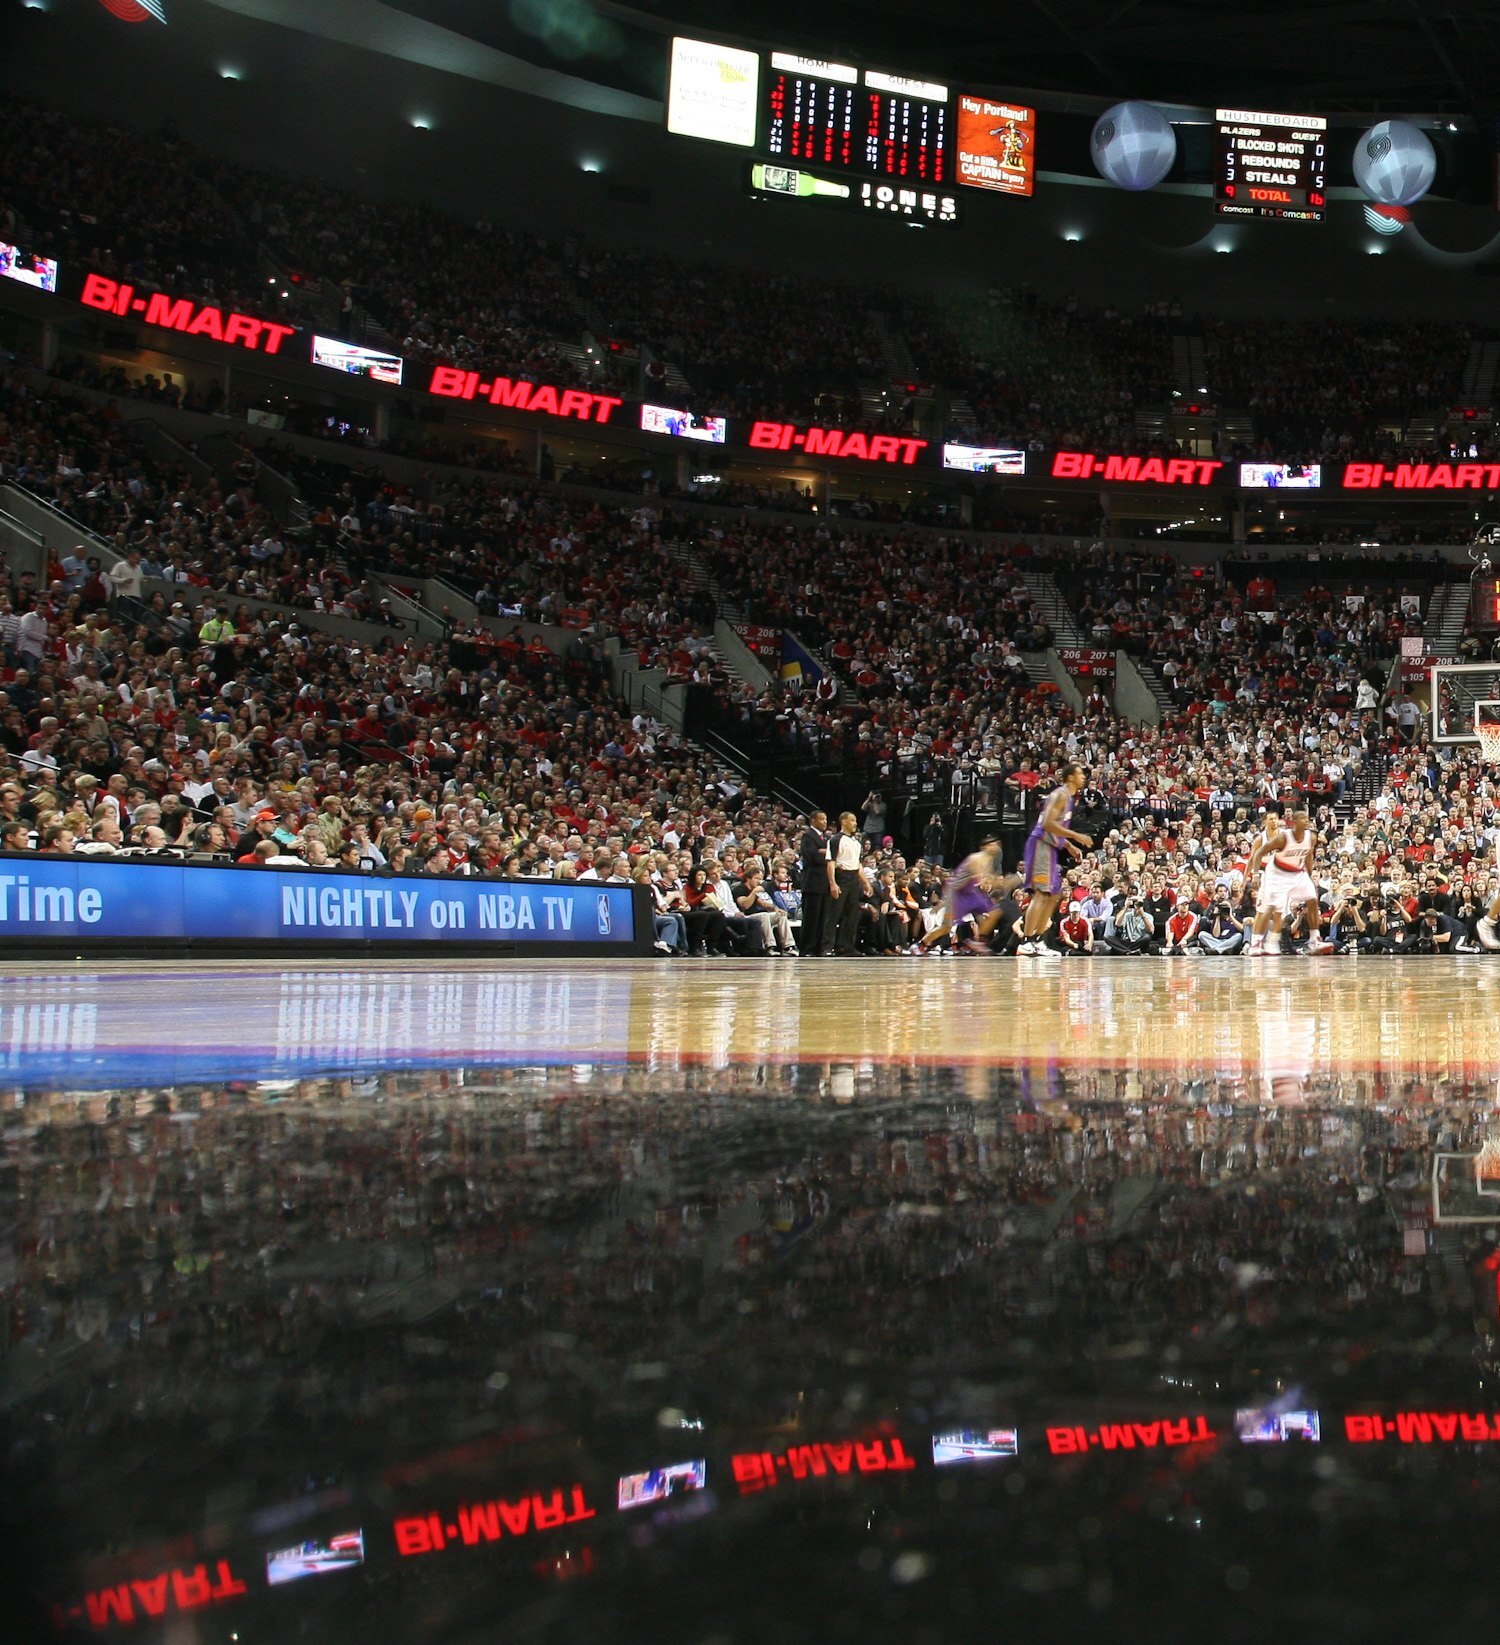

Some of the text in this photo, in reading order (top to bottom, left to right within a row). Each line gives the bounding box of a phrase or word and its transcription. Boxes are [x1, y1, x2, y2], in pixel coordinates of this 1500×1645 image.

[962, 98, 1027, 121] Hey Portland!
[1224, 112, 1319, 127] HUSTLEBOARD
[1221, 126, 1321, 141] BLAZERS GUEST
[1238, 139, 1324, 156] BLOCKED SHOTS 0
[960, 152, 974, 162] Got
[1227, 153, 1234, 165] 5
[1242, 155, 1300, 169] REBOUNDS
[961, 163, 1001, 180] CAPTAIN
[1227, 169, 1323, 188] 3 STEALS 5
[862, 183, 955, 213] JONES
[1226, 185, 1235, 197] 9
[1249, 188, 1291, 202] TOTAL
[864, 200, 912, 214] SODA
[1222, 205, 1320, 220] comcast It's Comcastic
[80, 273, 296, 354] BI-MART
[429, 365, 623, 424] BI-MART
[749, 421, 928, 465] BI-MART
[1051, 451, 1223, 485] BI-MART
[758, 628, 774, 637] 206
[760, 646, 774, 655] 105
[1063, 651, 1080, 659] 206
[1409, 673, 1424, 681] 105
[0, 876, 102, 923] Time
[282, 886, 574, 930] NIGHTLY on NBA TV
